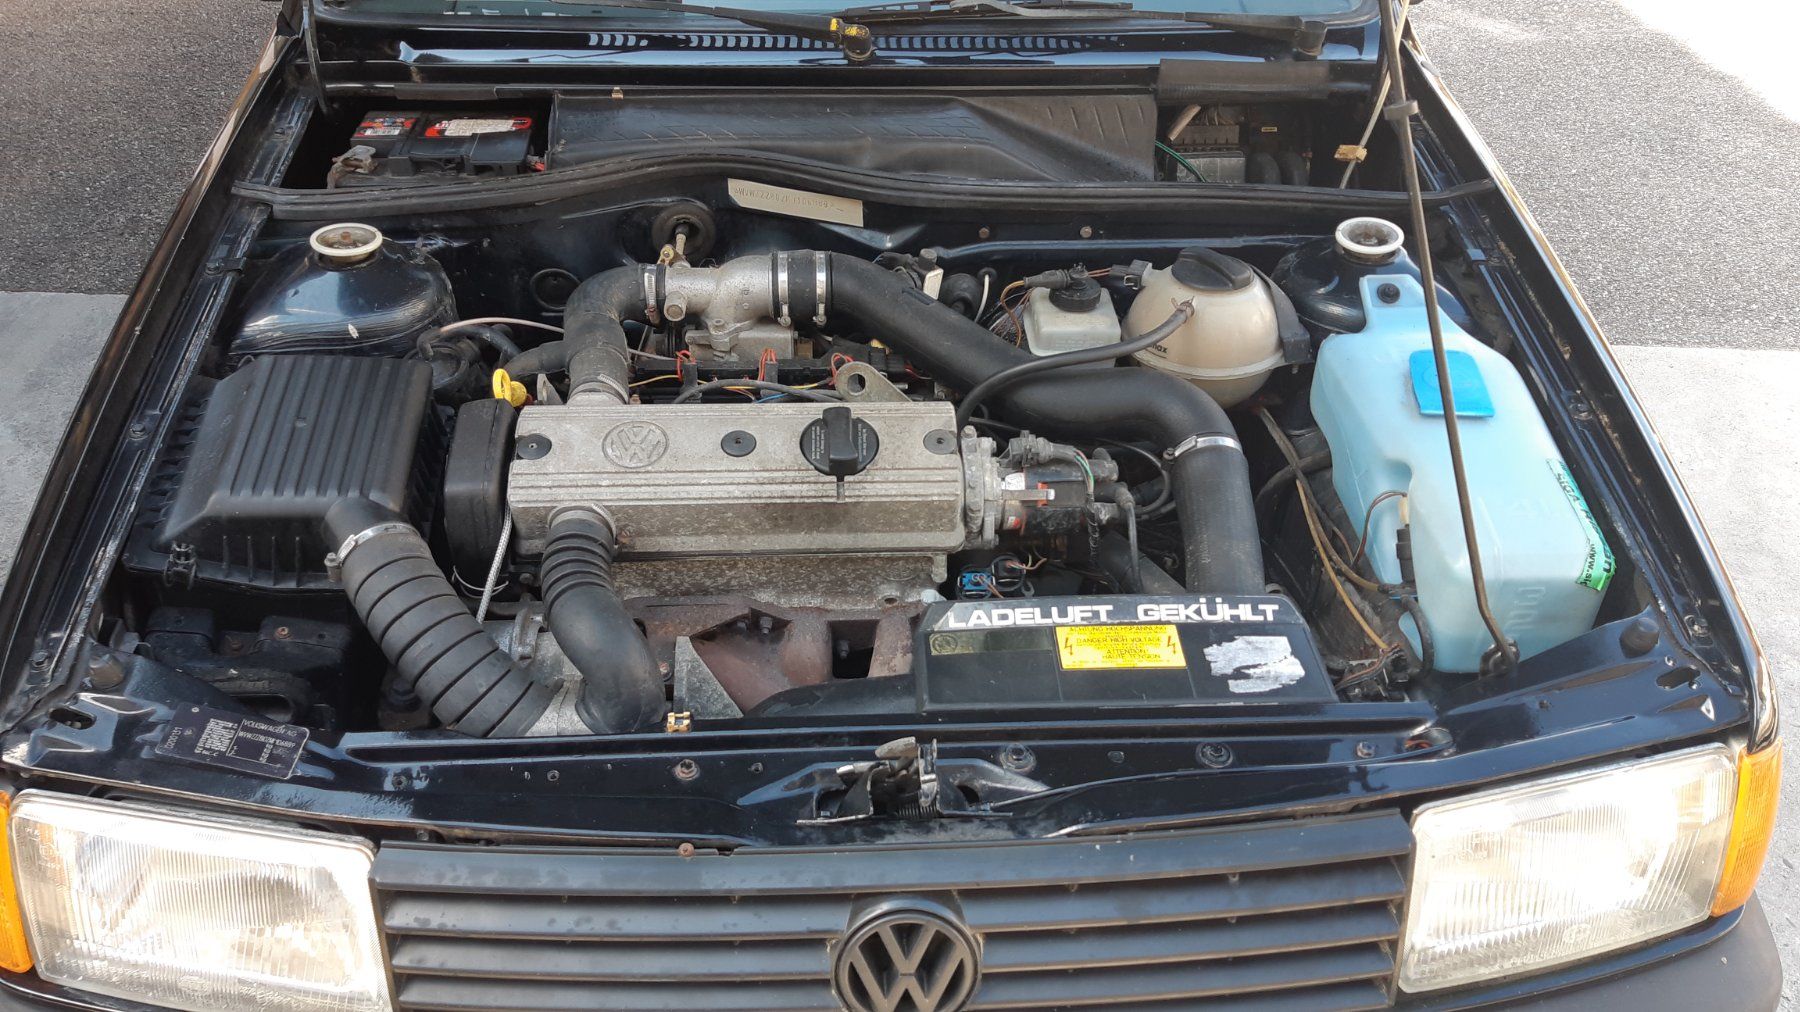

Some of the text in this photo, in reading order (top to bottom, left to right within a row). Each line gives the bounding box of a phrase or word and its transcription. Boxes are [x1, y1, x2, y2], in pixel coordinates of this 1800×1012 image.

[948, 598, 1279, 628] LADELUFT GEKÜHLT
[842, 917, 971, 1012] VW
